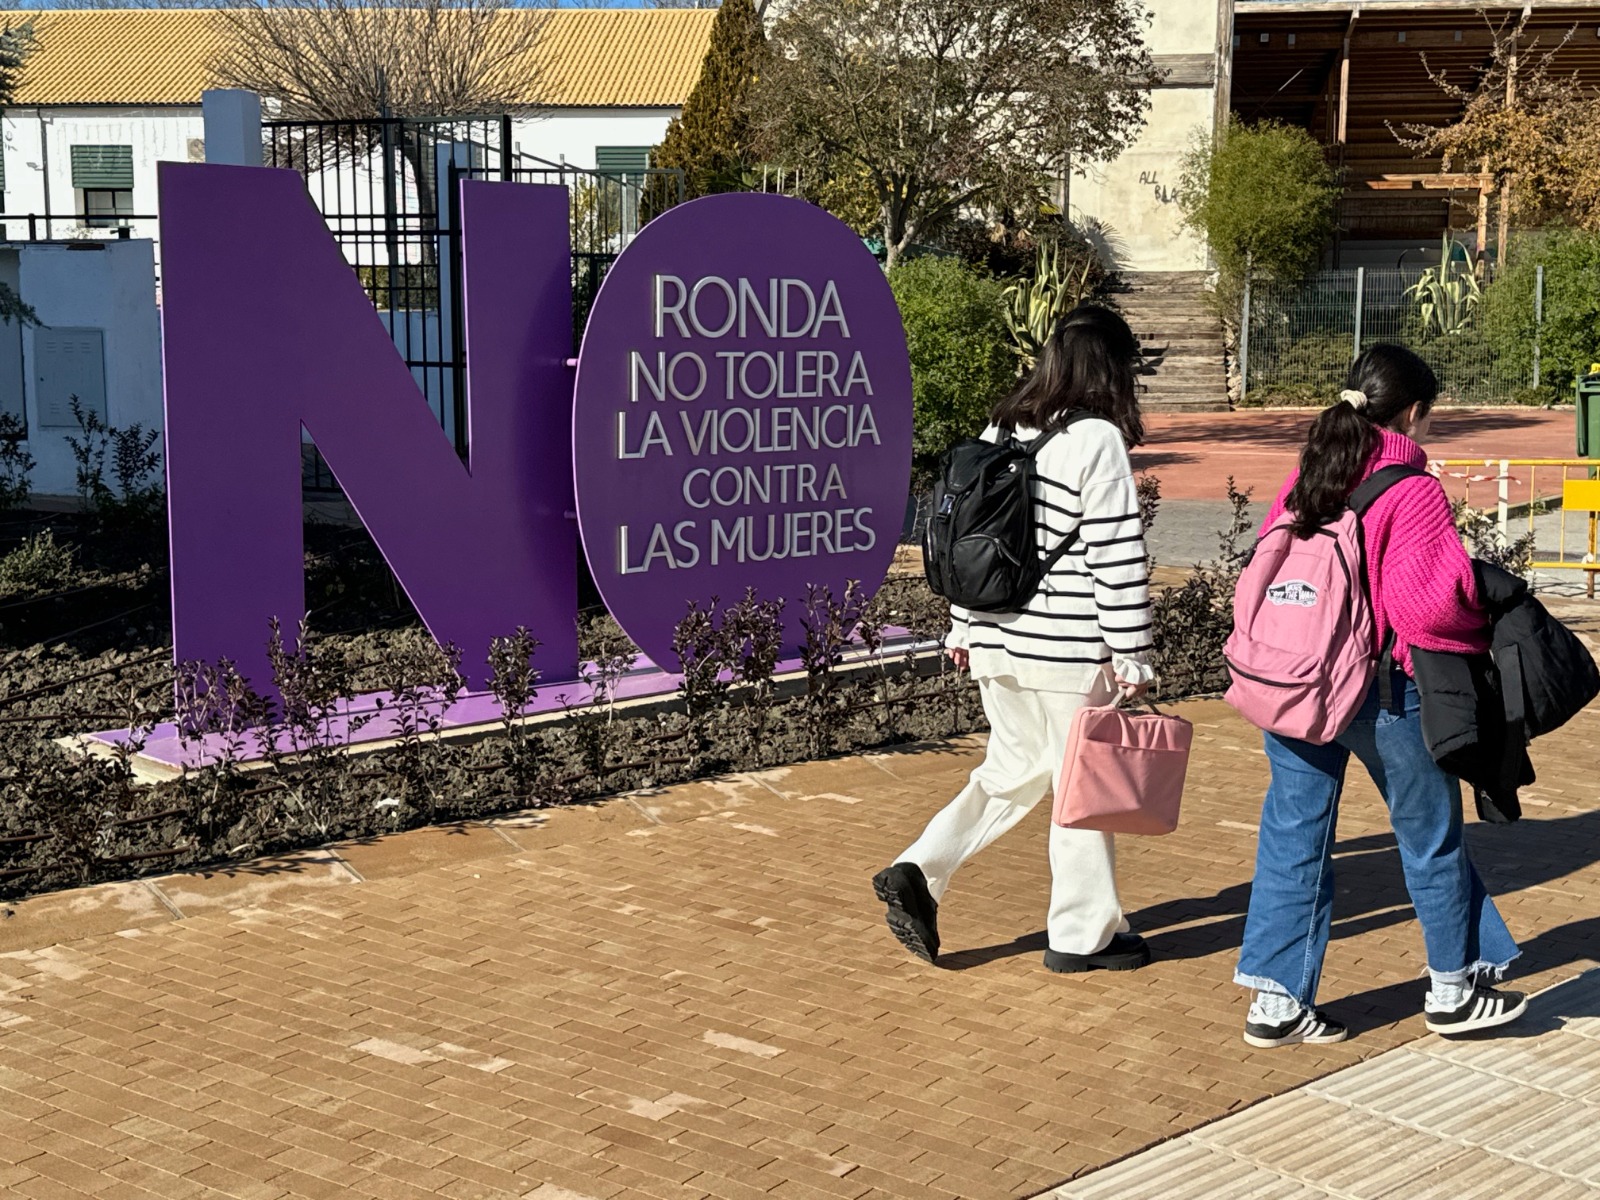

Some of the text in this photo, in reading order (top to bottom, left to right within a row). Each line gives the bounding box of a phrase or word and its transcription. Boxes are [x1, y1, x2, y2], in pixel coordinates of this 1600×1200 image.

[1139, 171, 1158, 184] ALL
[655, 274, 851, 339] RONDA
[630, 350, 874, 402] NO TOLERA
[618, 403, 881, 459] LA VIOLENCIA
[682, 463, 848, 508] CONTRA
[620, 507, 876, 575] LAS MUJERES
